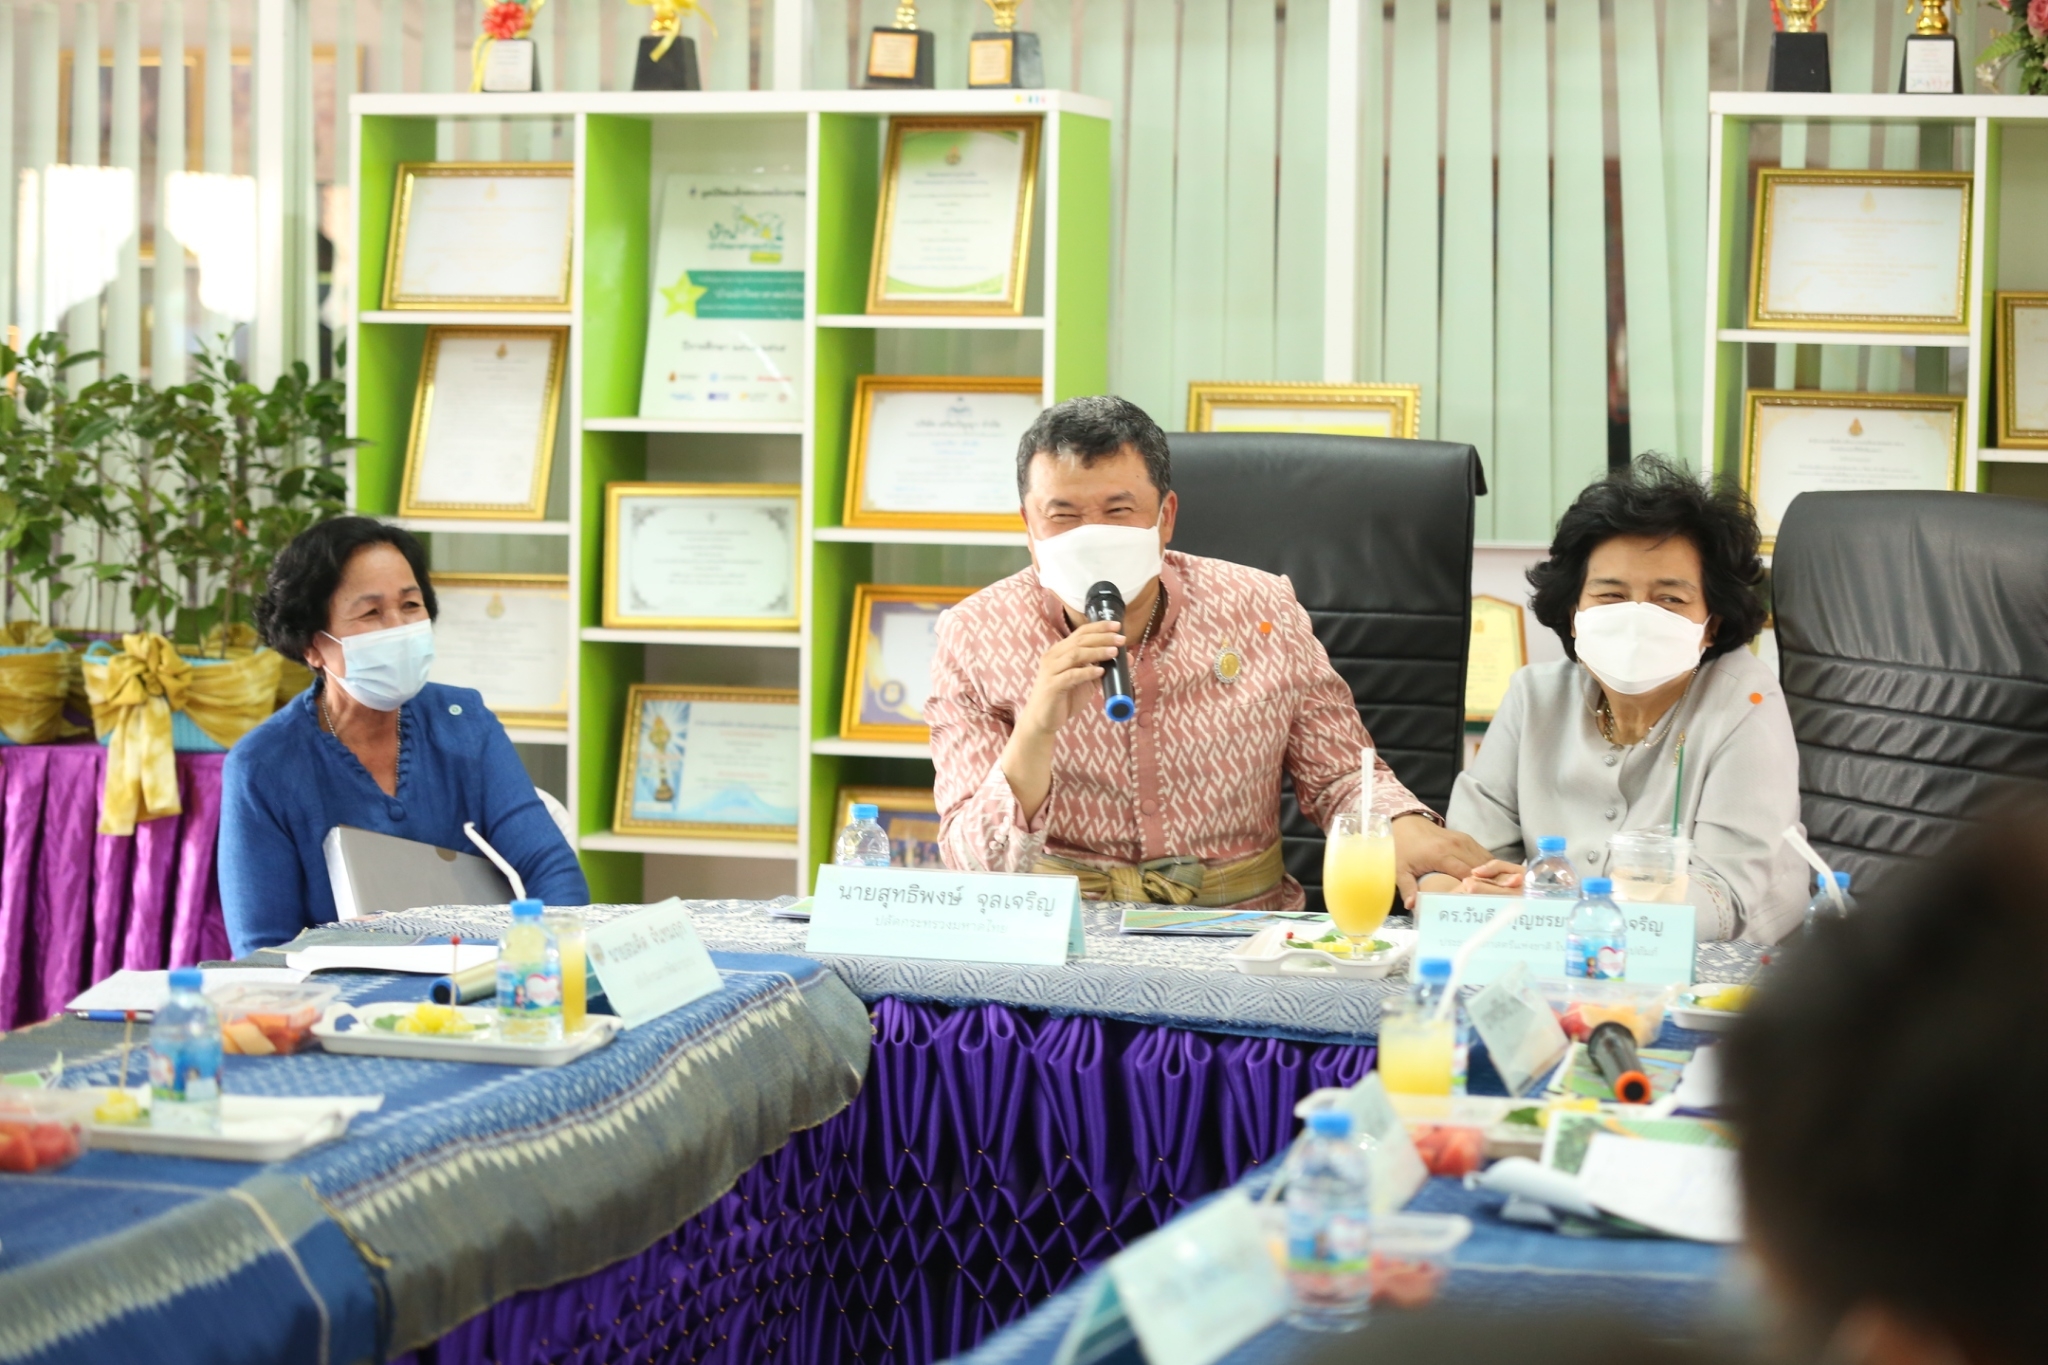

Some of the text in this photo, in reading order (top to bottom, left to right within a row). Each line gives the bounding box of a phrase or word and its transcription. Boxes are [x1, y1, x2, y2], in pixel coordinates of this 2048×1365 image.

[838, 883, 1056, 917] นายสุทธิพงษ์ จุลเจริญ
[874, 914, 1009, 934] ปลัดกระทรวงมหาดไทย
